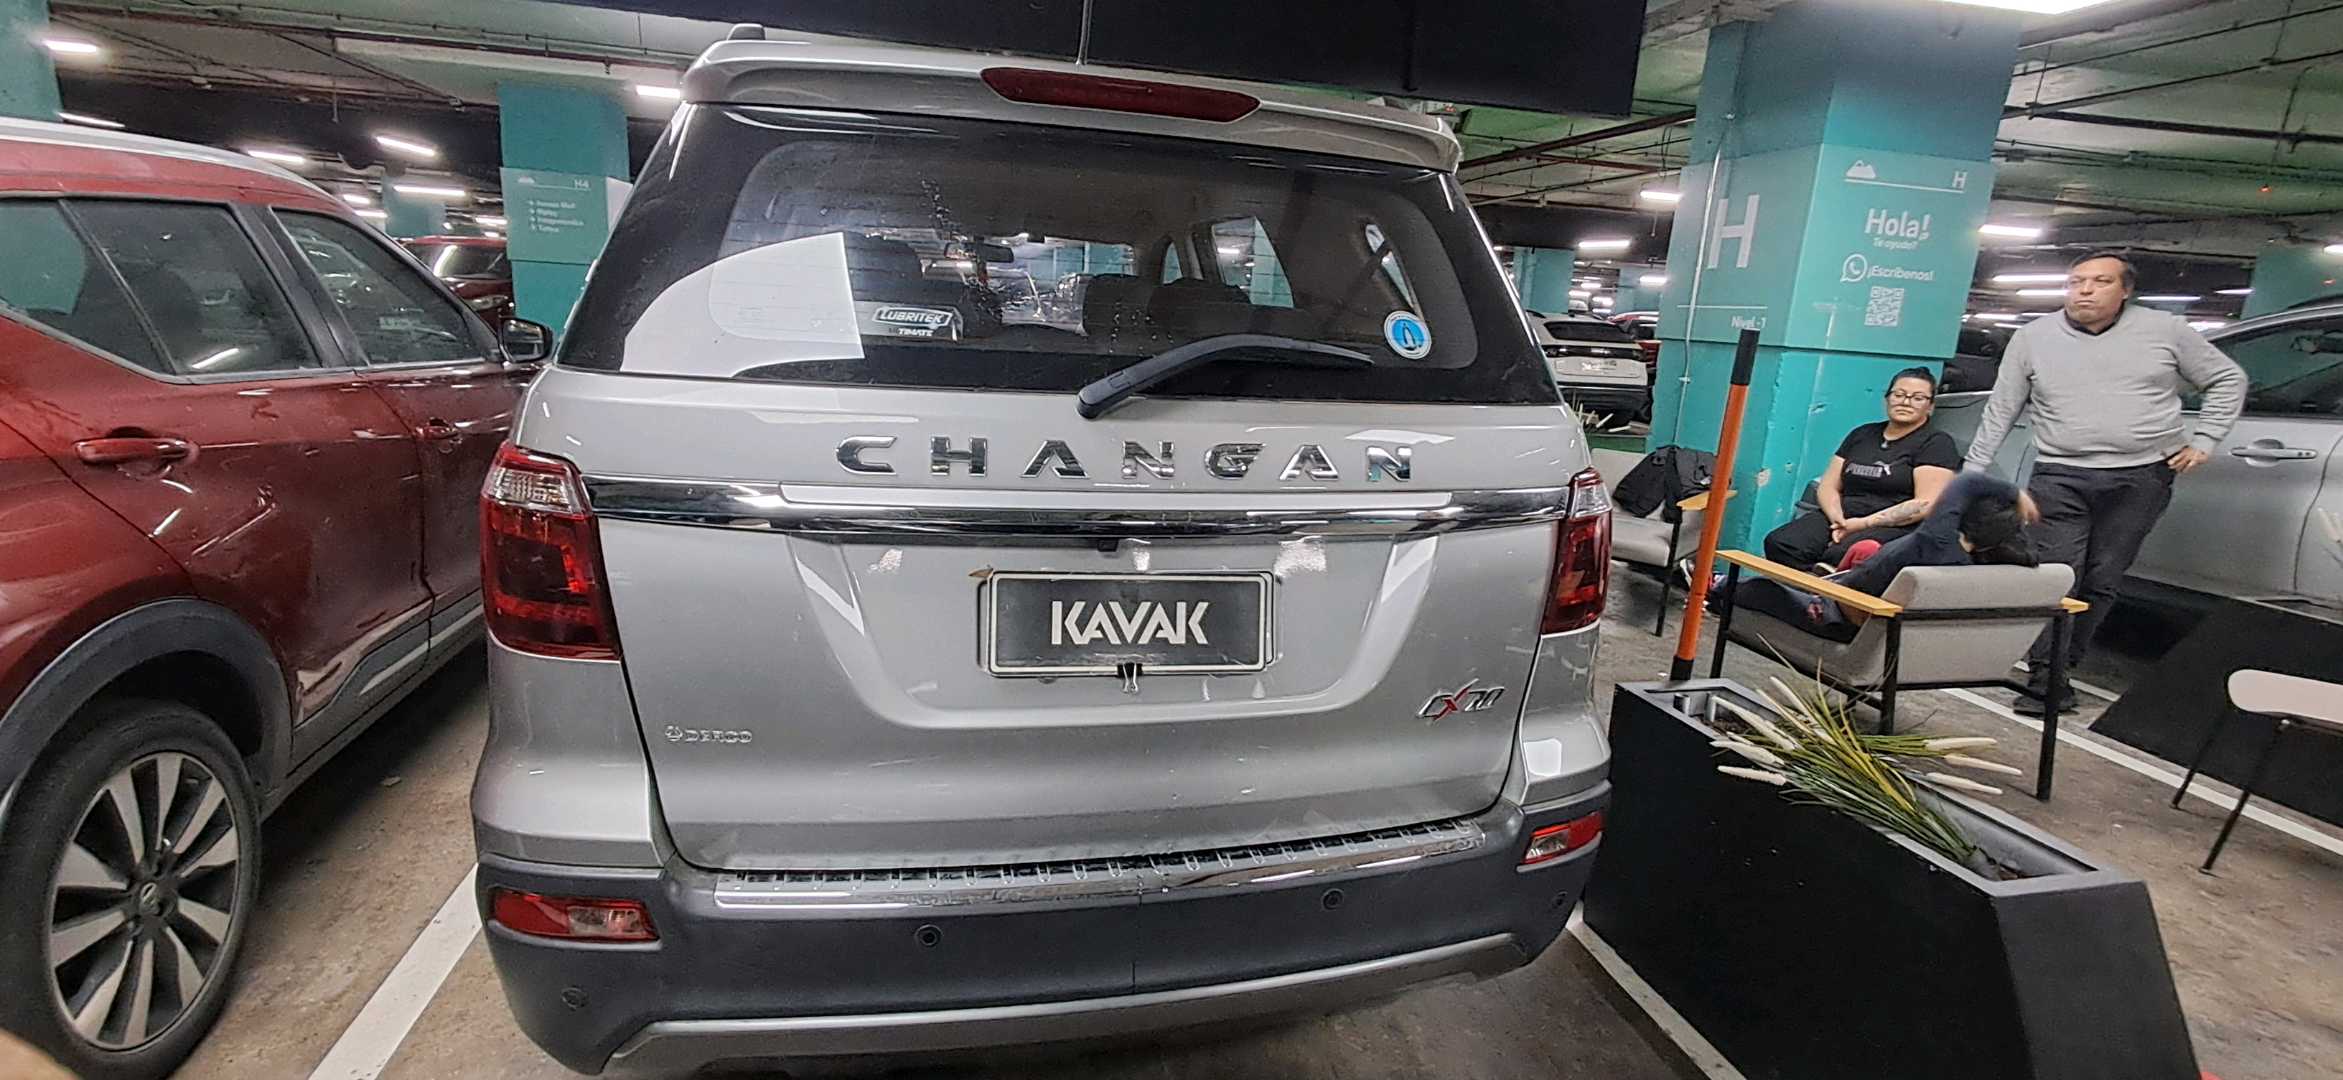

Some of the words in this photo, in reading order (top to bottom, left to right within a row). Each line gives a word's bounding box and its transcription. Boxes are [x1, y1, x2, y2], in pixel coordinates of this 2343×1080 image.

[1952, 171, 1968, 189] H
[1706, 194, 1760, 269] H
[1864, 207, 1931, 241] Hola!
[879, 306, 945, 323] LUBRITEK
[836, 435, 1412, 482] CHANGAN
[1051, 601, 1209, 645] KAVAK
